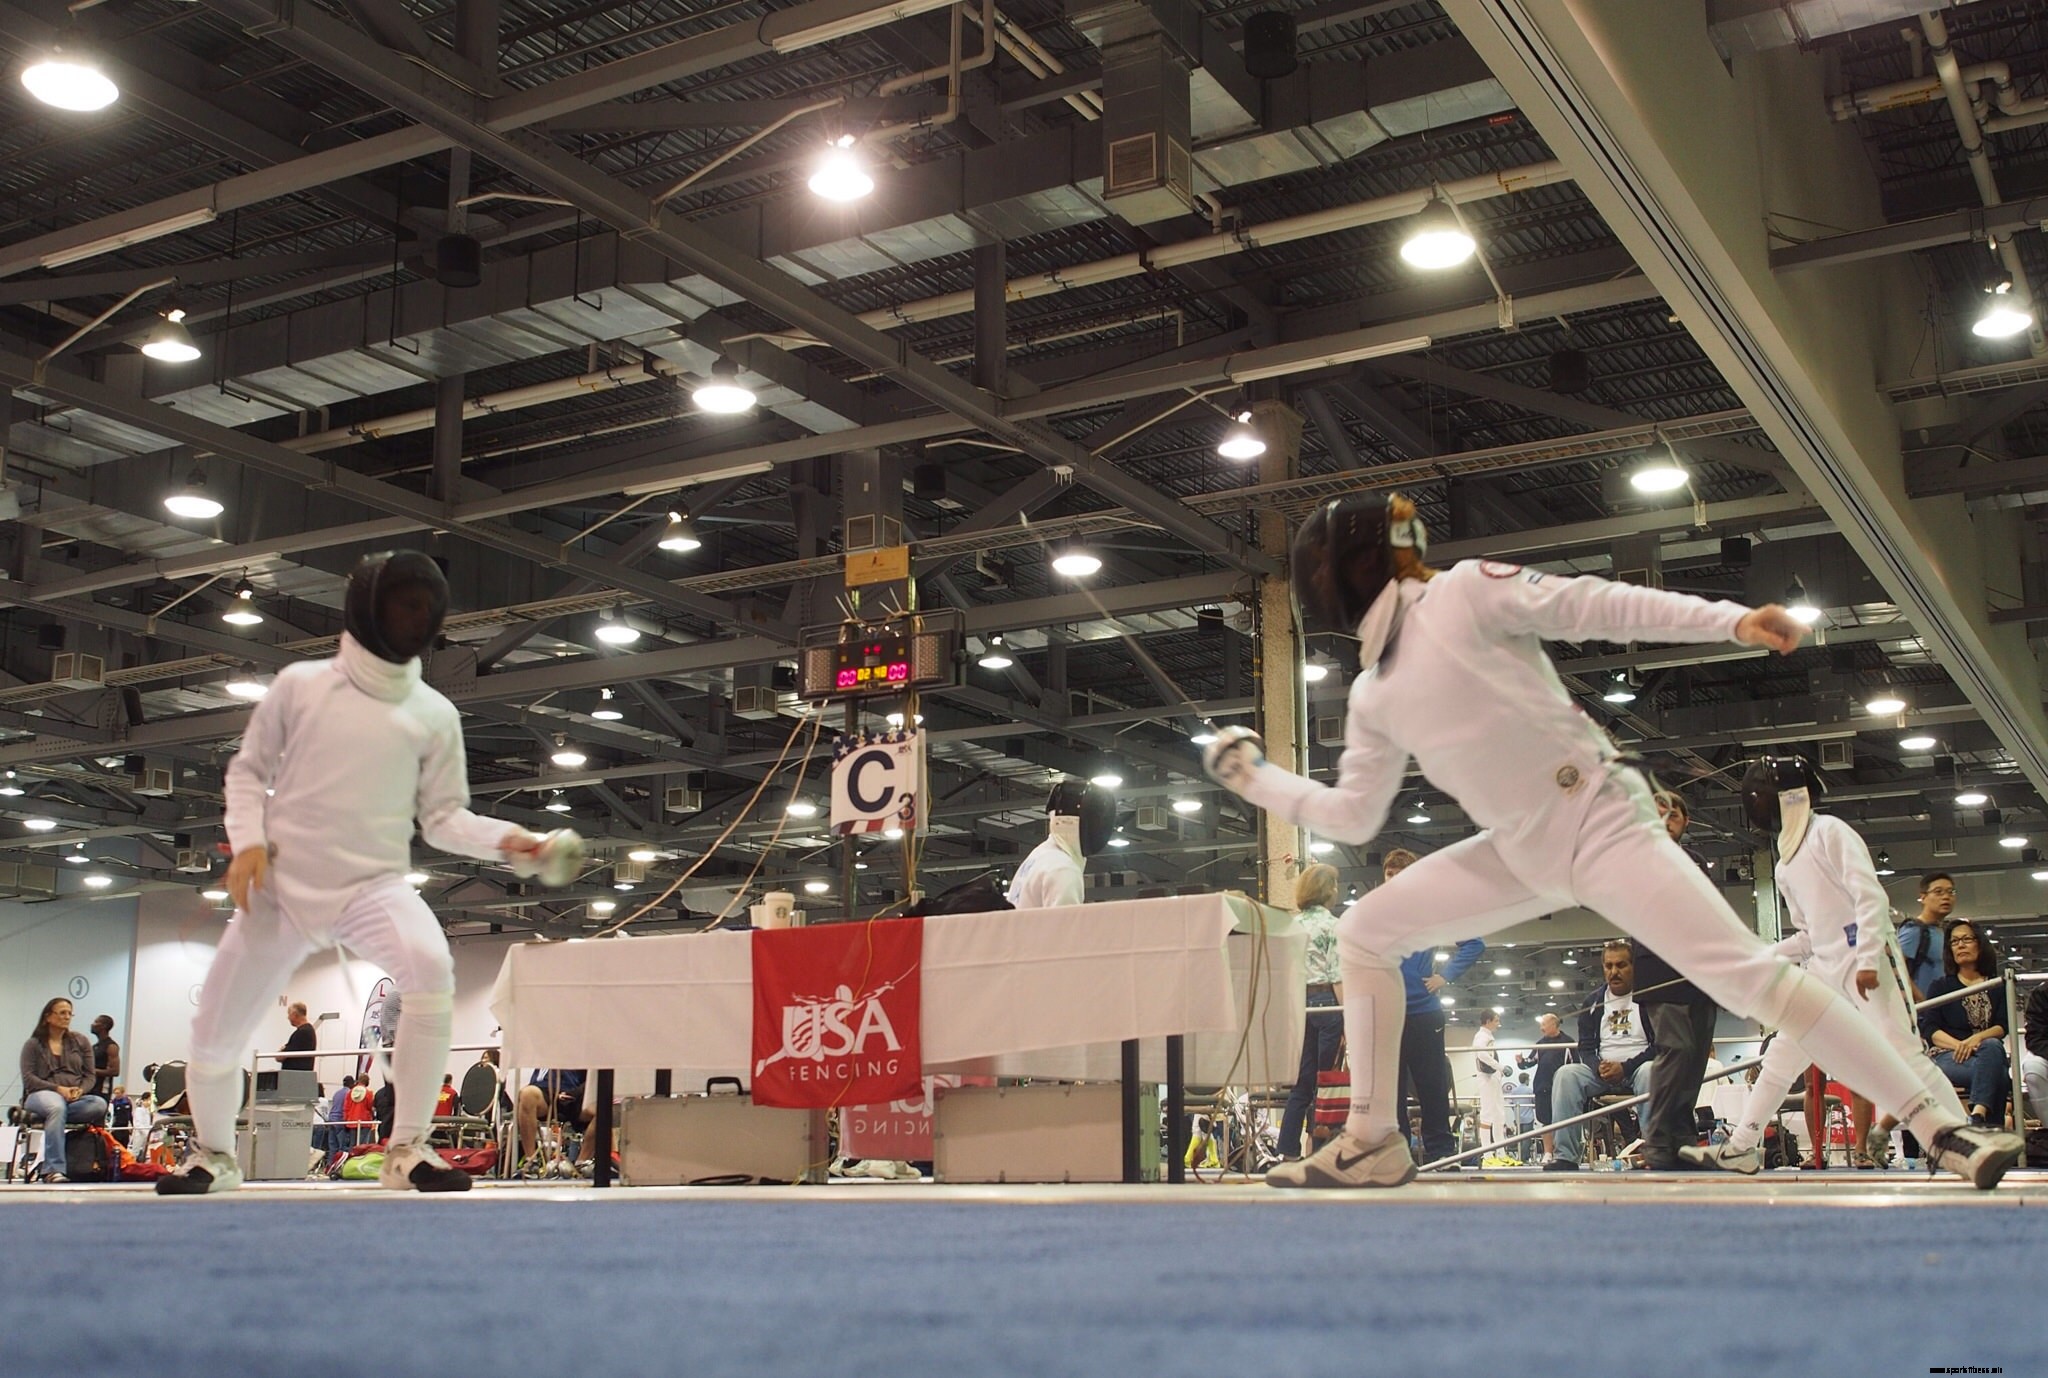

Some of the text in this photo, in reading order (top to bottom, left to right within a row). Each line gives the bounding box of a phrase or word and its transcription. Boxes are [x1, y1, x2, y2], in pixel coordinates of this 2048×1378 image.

[847, 750, 895, 813] C
[897, 792, 914, 820] 3
[782, 998, 902, 1059] USA
[789, 1059, 899, 1081] FENCING
